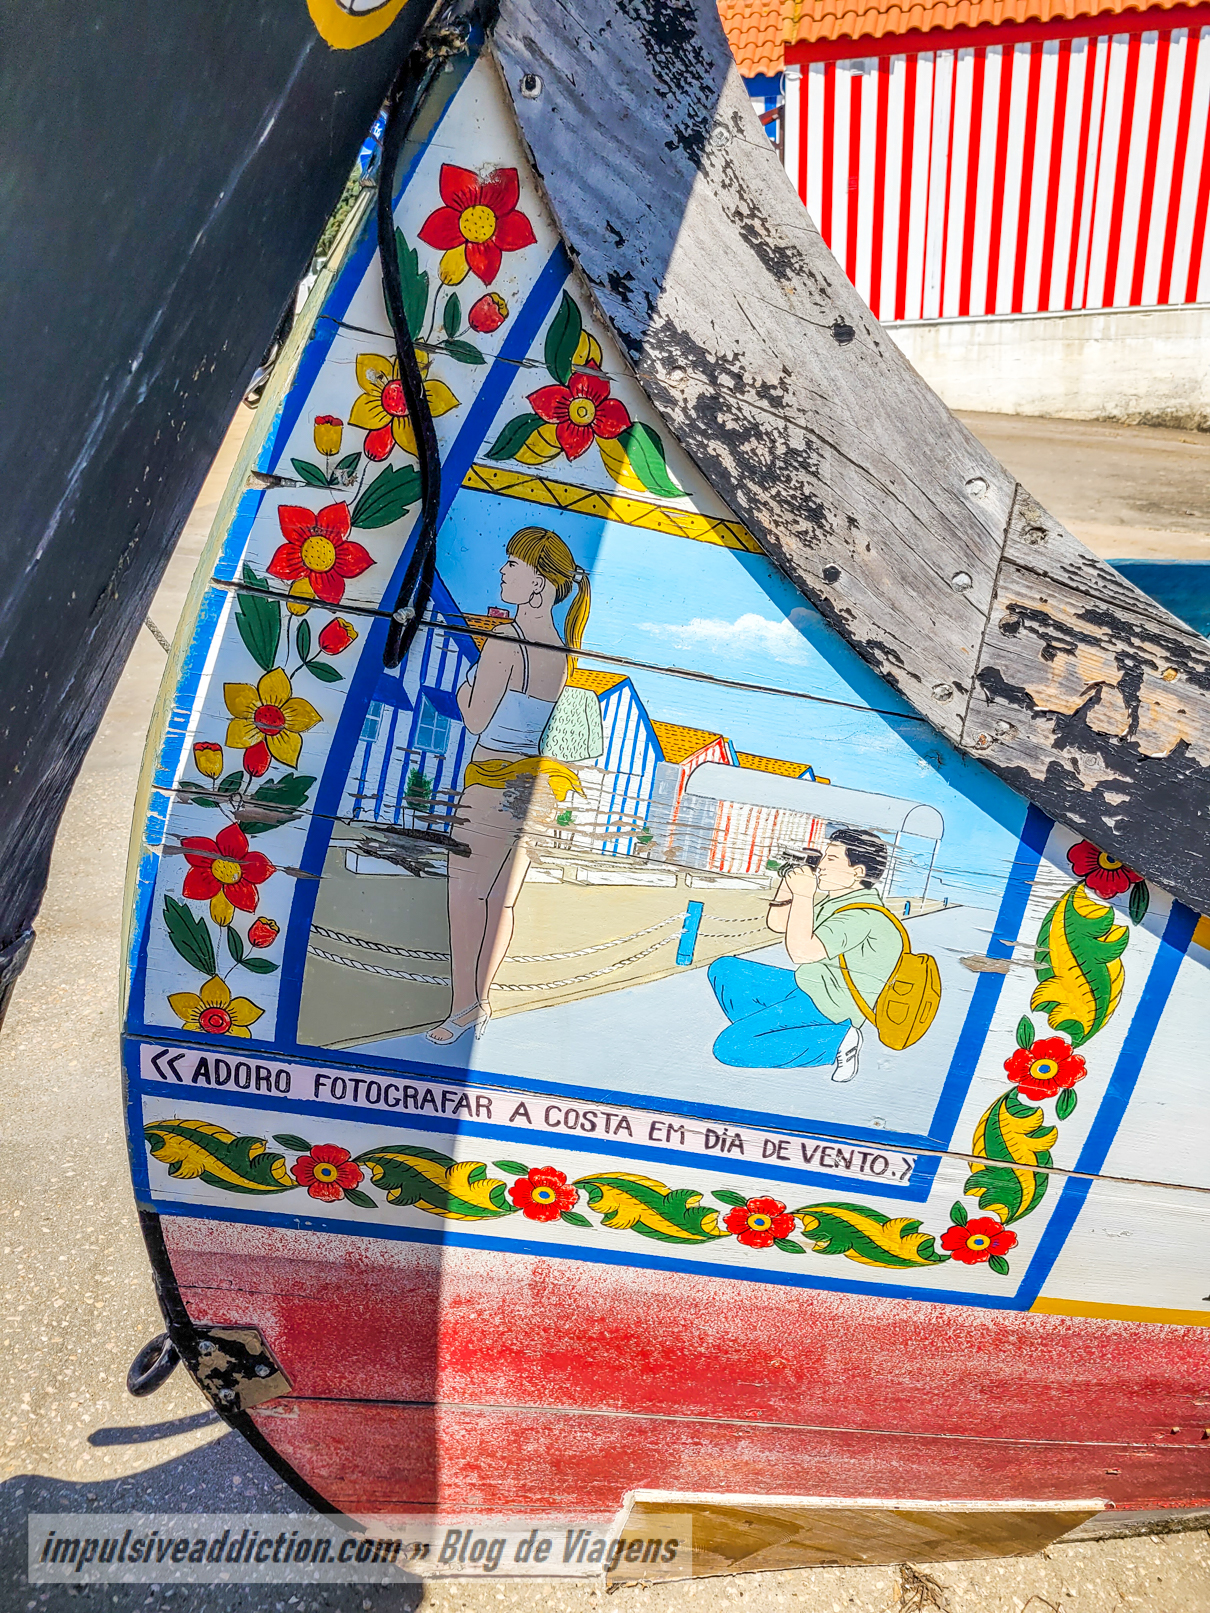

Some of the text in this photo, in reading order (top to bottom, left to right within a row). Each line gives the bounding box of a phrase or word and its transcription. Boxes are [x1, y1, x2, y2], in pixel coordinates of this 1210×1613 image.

[313, 1073, 493, 1120] FOTOGRAFAR
[508, 1101, 533, 1125] A
[544, 1105, 634, 1138] COSTA
[648, 1120, 686, 1146] EM
[762, 1138, 792, 1161] DE
